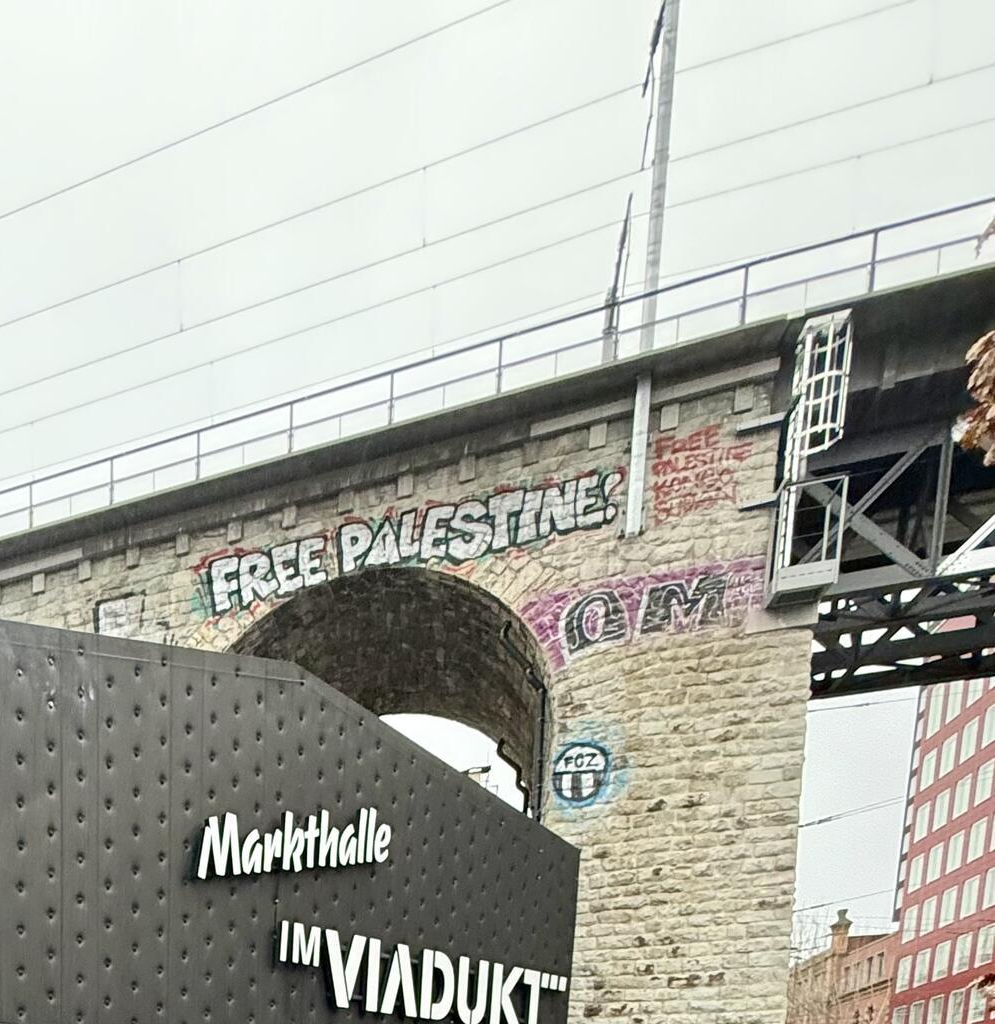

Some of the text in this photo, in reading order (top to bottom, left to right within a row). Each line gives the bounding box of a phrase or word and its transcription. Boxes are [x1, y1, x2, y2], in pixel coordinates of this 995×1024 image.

[208, 535, 329, 613] FREE
[564, 753, 599, 769] FCZ
[197, 807, 392, 880] Markthalle
[279, 920, 321, 967] IM
